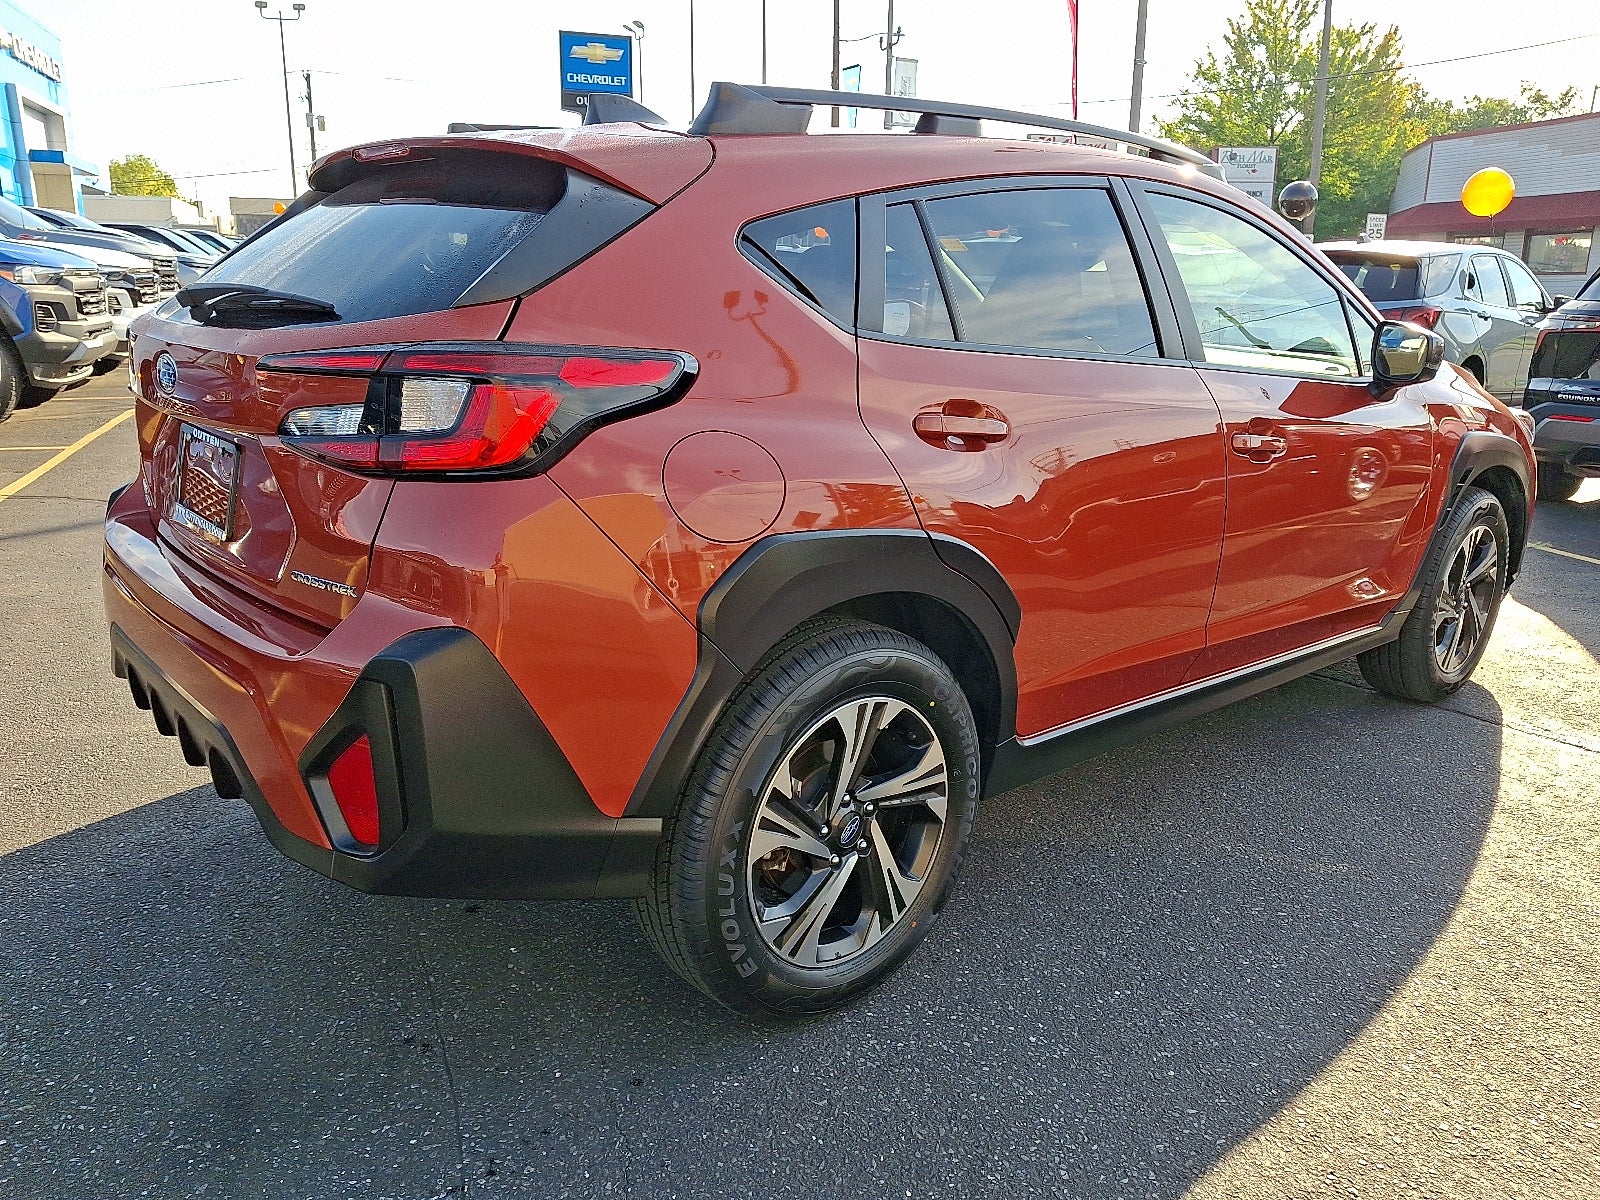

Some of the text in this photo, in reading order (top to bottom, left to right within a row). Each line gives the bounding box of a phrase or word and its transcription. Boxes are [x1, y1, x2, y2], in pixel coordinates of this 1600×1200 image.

[567, 73, 627, 86] CHEVROLET
[1368, 228, 1383, 239] 25
[1557, 393, 1596, 403] EQUINOX
[192, 428, 220, 448] OUTTEN
[290, 570, 358, 598] CROSSTREK
[717, 815, 759, 979] EVOLUXX
